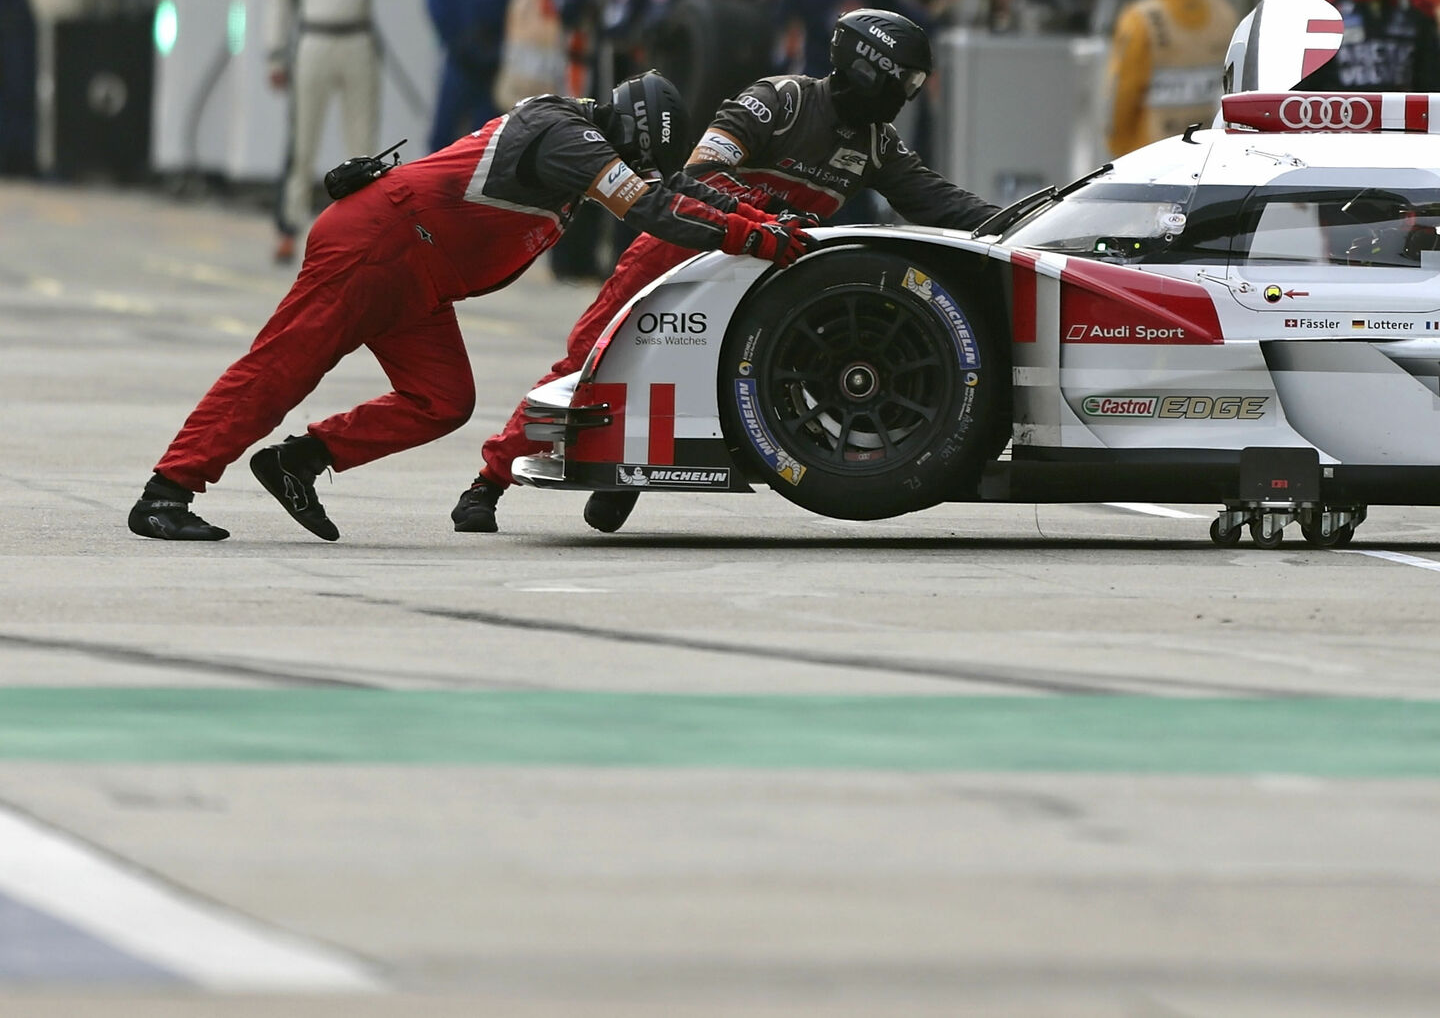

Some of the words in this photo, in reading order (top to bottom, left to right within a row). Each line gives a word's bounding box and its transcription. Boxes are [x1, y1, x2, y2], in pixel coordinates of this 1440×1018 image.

[869, 25, 897, 48] uvex
[856, 41, 904, 78] uvex
[661, 111, 671, 143] uvex
[637, 312, 708, 334] ORIS
[935, 294, 976, 364] MICHELIN
[1089, 326, 1130, 339] Audi
[1136, 326, 1185, 341] Sport
[1299, 317, 1340, 330] Fässler
[1367, 318, 1414, 331] Lotterer
[635, 336, 667, 346] Swiss
[669, 335, 708, 347] Watches
[739, 382, 775, 456] MICHELIN
[1100, 398, 1154, 416] Castrol
[1158, 396, 1270, 420] EDGE
[650, 470, 727, 482] MICHELIN
